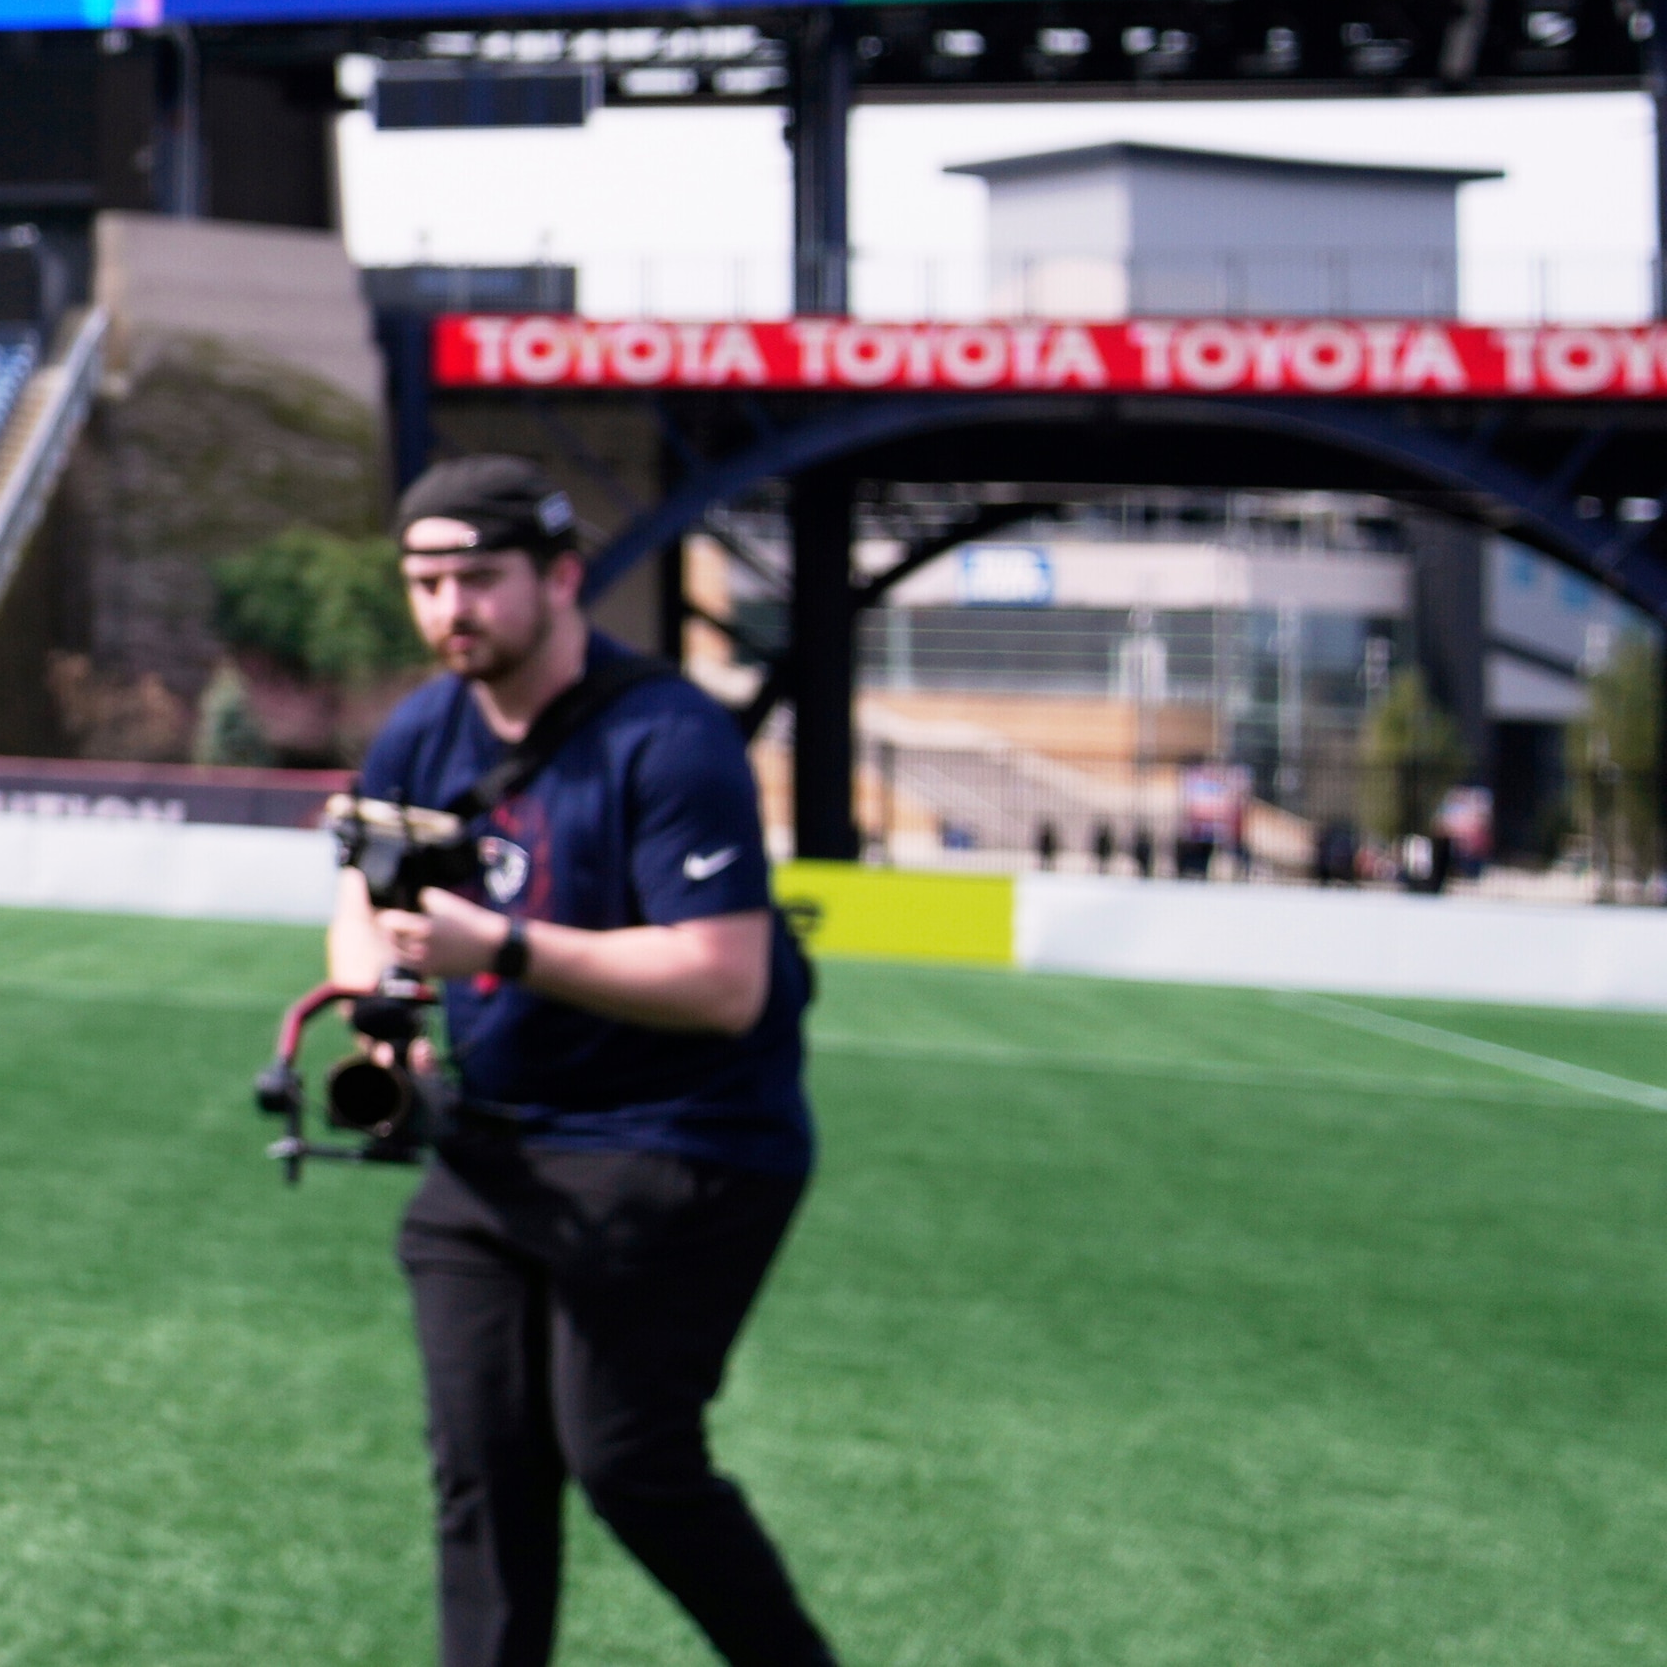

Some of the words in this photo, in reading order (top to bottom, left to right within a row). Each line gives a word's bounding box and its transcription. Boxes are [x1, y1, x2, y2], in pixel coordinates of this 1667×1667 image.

[462, 321, 766, 386] TOYOTA
[792, 324, 1110, 391] TOYOTA
[1130, 325, 1468, 394] TOYOTA
